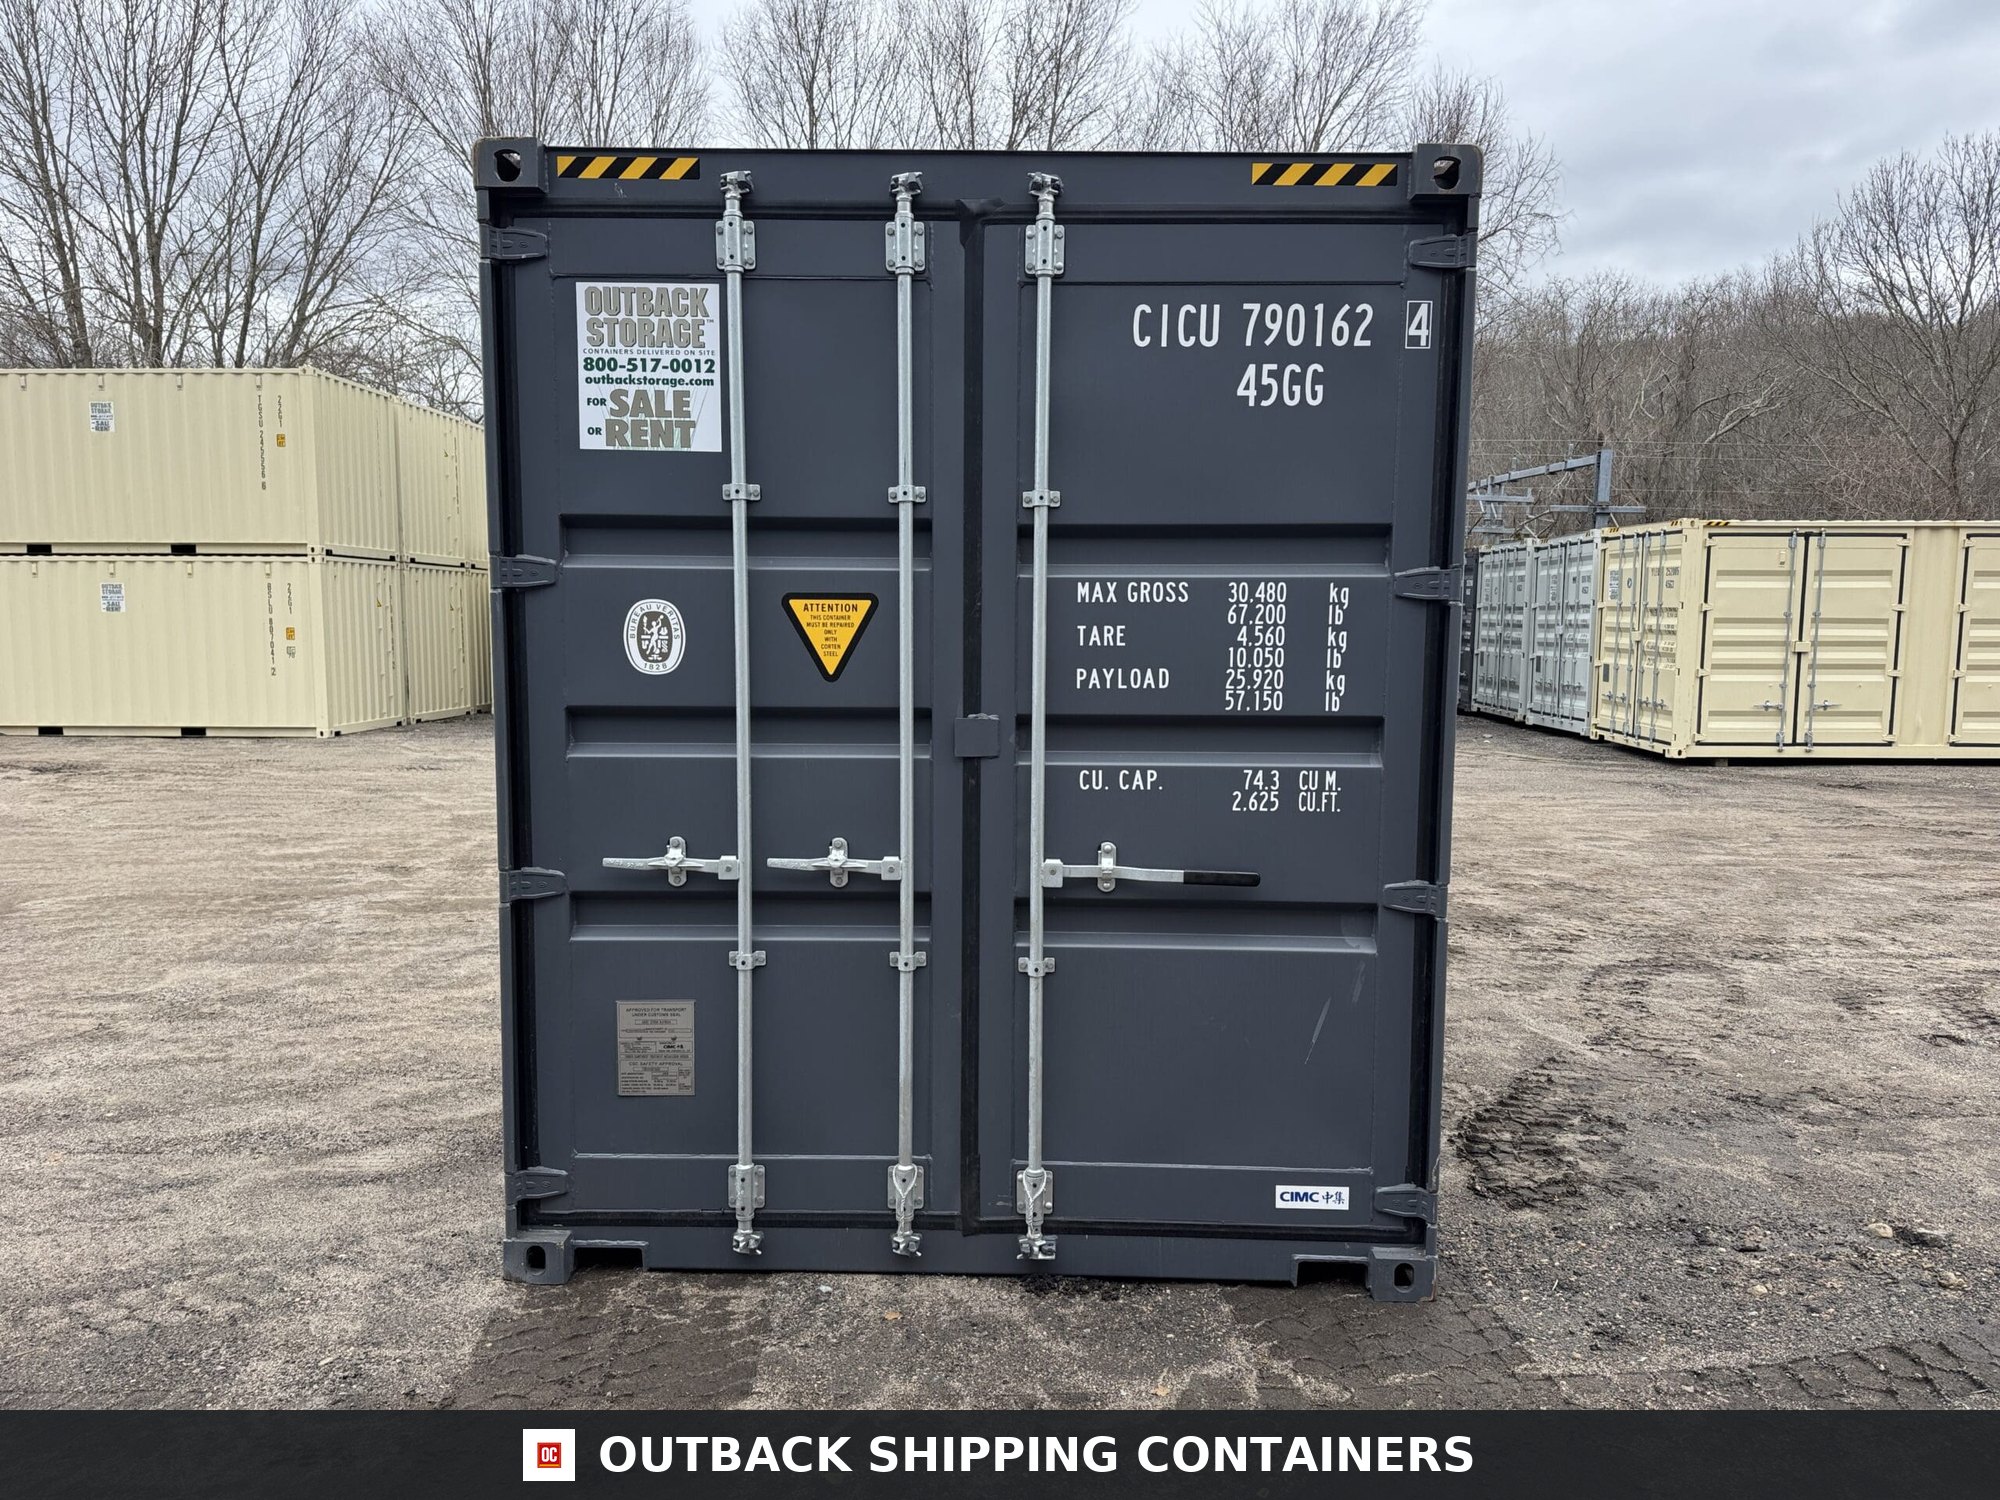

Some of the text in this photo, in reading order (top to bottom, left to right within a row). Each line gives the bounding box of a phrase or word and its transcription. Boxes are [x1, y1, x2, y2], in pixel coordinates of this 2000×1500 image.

[584, 286, 710, 317] OUTBACK
[586, 317, 706, 349] STORAGE
[1133, 303, 1429, 347] CICU 790162 4
[583, 357, 715, 373] 800-517-0012
[585, 374, 714, 387] outbackstorage.com
[1236, 363, 1324, 407] 45GG
[587, 388, 691, 418] FOR SALE
[587, 419, 696, 448] OR RENT
[803, 603, 858, 612] ATTENTION
[1077, 582, 1117, 603] MAX
[1127, 582, 1190, 603] GROSS
[1329, 582, 1350, 609] kg
[630, 604, 680, 640] BUREAU VERITAS
[1328, 604, 1344, 625] lb
[1077, 625, 1126, 647] TARE
[1327, 627, 1347, 652] kg
[1326, 649, 1342, 669] lb
[1076, 668, 1170, 689] PAYLOAD
[1325, 670, 1346, 696] kg
[1325, 692, 1340, 712] lb
[1079, 770, 1341, 791] CU. CAP. 74.3 CU M.
[1298, 791, 1341, 812] CU.FT.
[1280, 1191, 1319, 1202] CIMC
[1322, 1191, 1345, 1204] 中集
